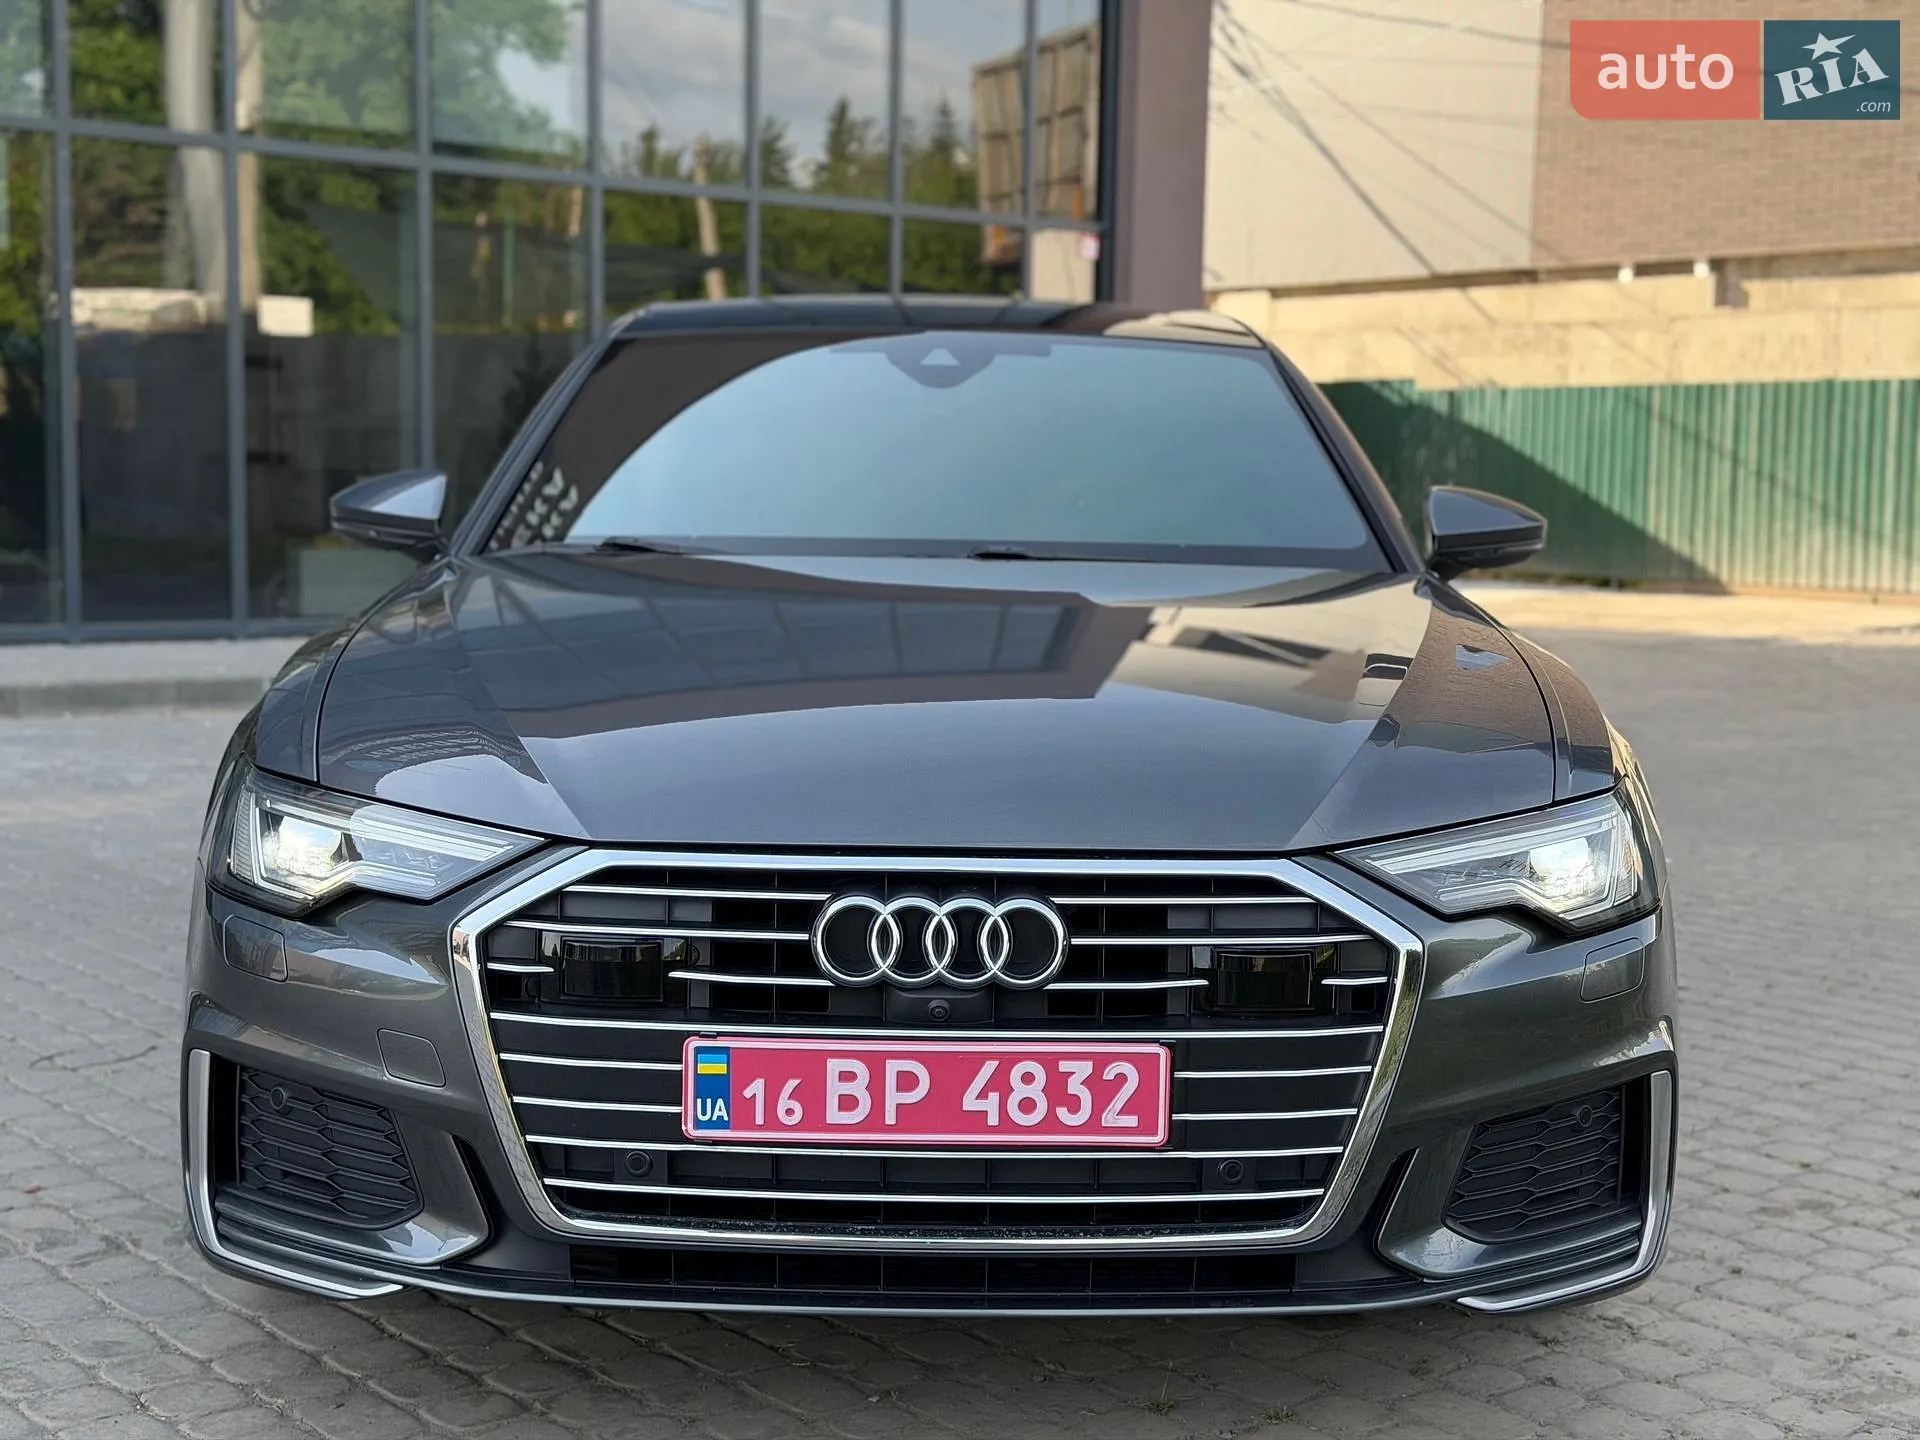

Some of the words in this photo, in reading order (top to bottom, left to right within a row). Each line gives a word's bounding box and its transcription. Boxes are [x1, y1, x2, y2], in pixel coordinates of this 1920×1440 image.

[696, 1097, 729, 1122] UA
[742, 1078, 804, 1126] 16
[826, 1058, 931, 1126] BP
[962, 1060, 1140, 1128] 4832
